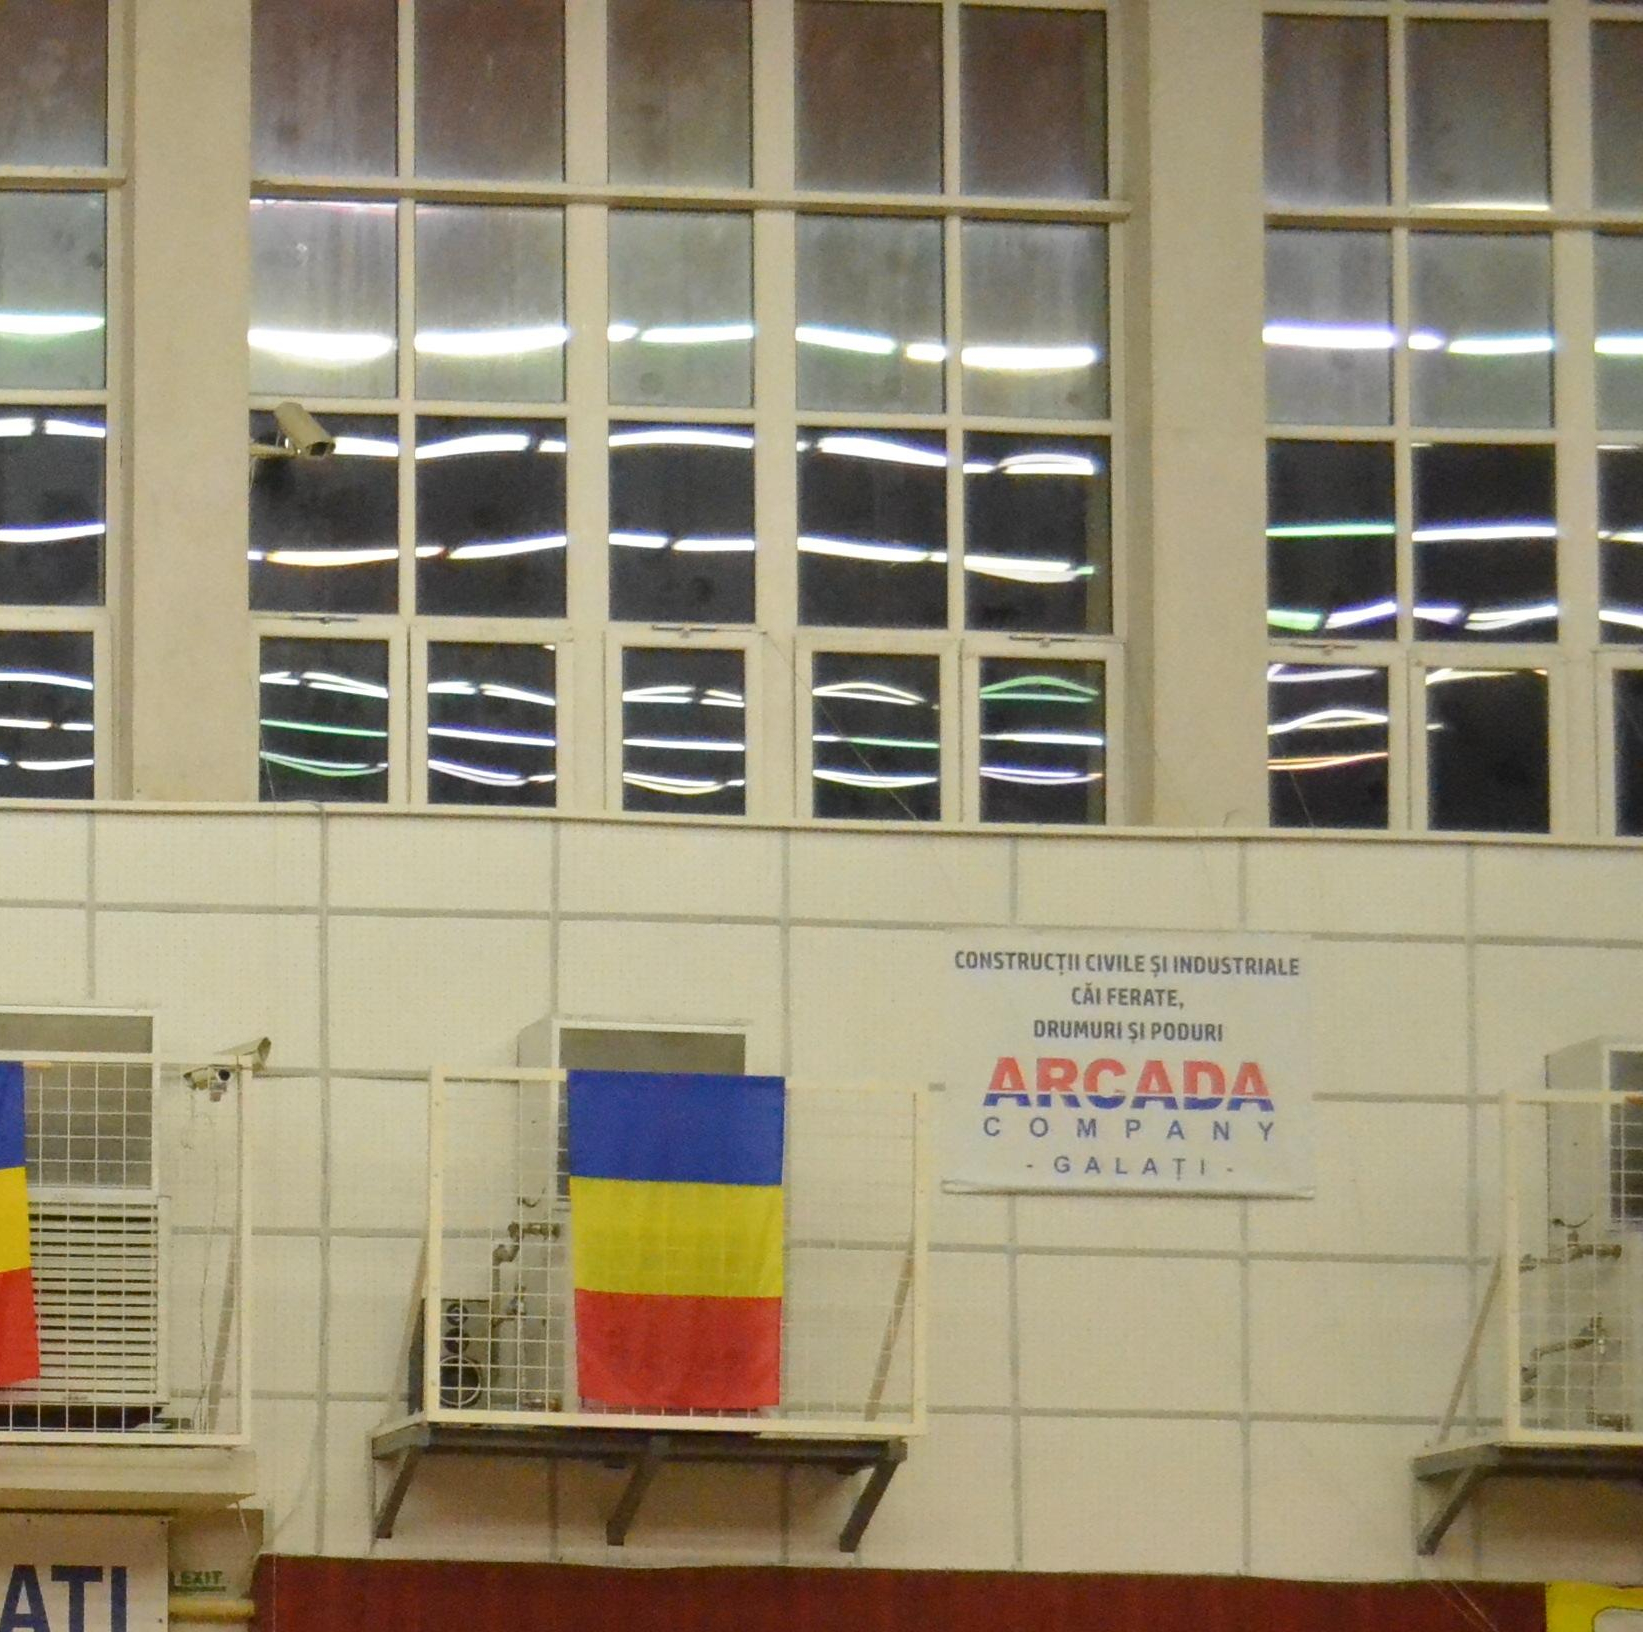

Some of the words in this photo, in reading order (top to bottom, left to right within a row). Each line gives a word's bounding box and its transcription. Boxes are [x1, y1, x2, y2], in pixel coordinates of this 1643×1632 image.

[954, 951, 1080, 976] CONSTRUCȚII
[1086, 954, 1145, 972] CIVILE
[1151, 954, 1168, 978] ȘI
[1174, 955, 1300, 976] INDUSTRIALE
[1071, 983, 1102, 1006] CĂI
[1107, 988, 1185, 1009] FERATE,
[1033, 1020, 1123, 1040] DRUMURI
[1128, 1021, 1145, 1044] ȘI
[1151, 1022, 1223, 1042] PODURI
[983, 1056, 1275, 1112] ARCADA
[983, 1116, 1275, 1141] COMPANY
